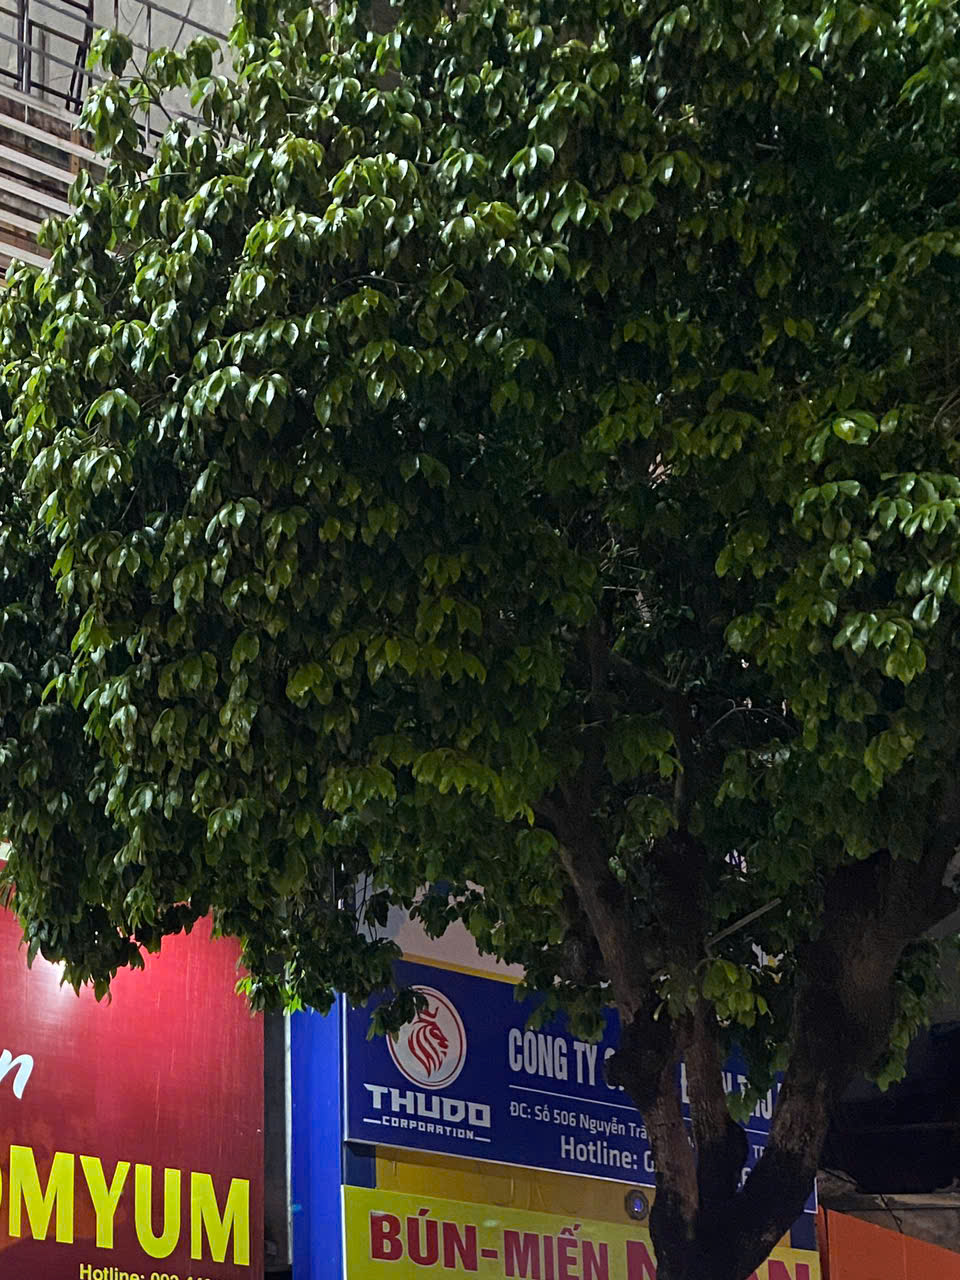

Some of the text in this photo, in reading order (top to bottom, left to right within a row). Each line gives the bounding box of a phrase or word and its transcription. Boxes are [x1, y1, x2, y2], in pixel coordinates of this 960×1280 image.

[573, 1041, 598, 1086] TY
[363, 1083, 491, 1128] THUDO
[510, 1101, 648, 1140] ĐC: Số 506 Nguyễn Trã
[382, 1115, 474, 1140] CORPORATION
[560, 1135, 638, 1170] Hotline:
